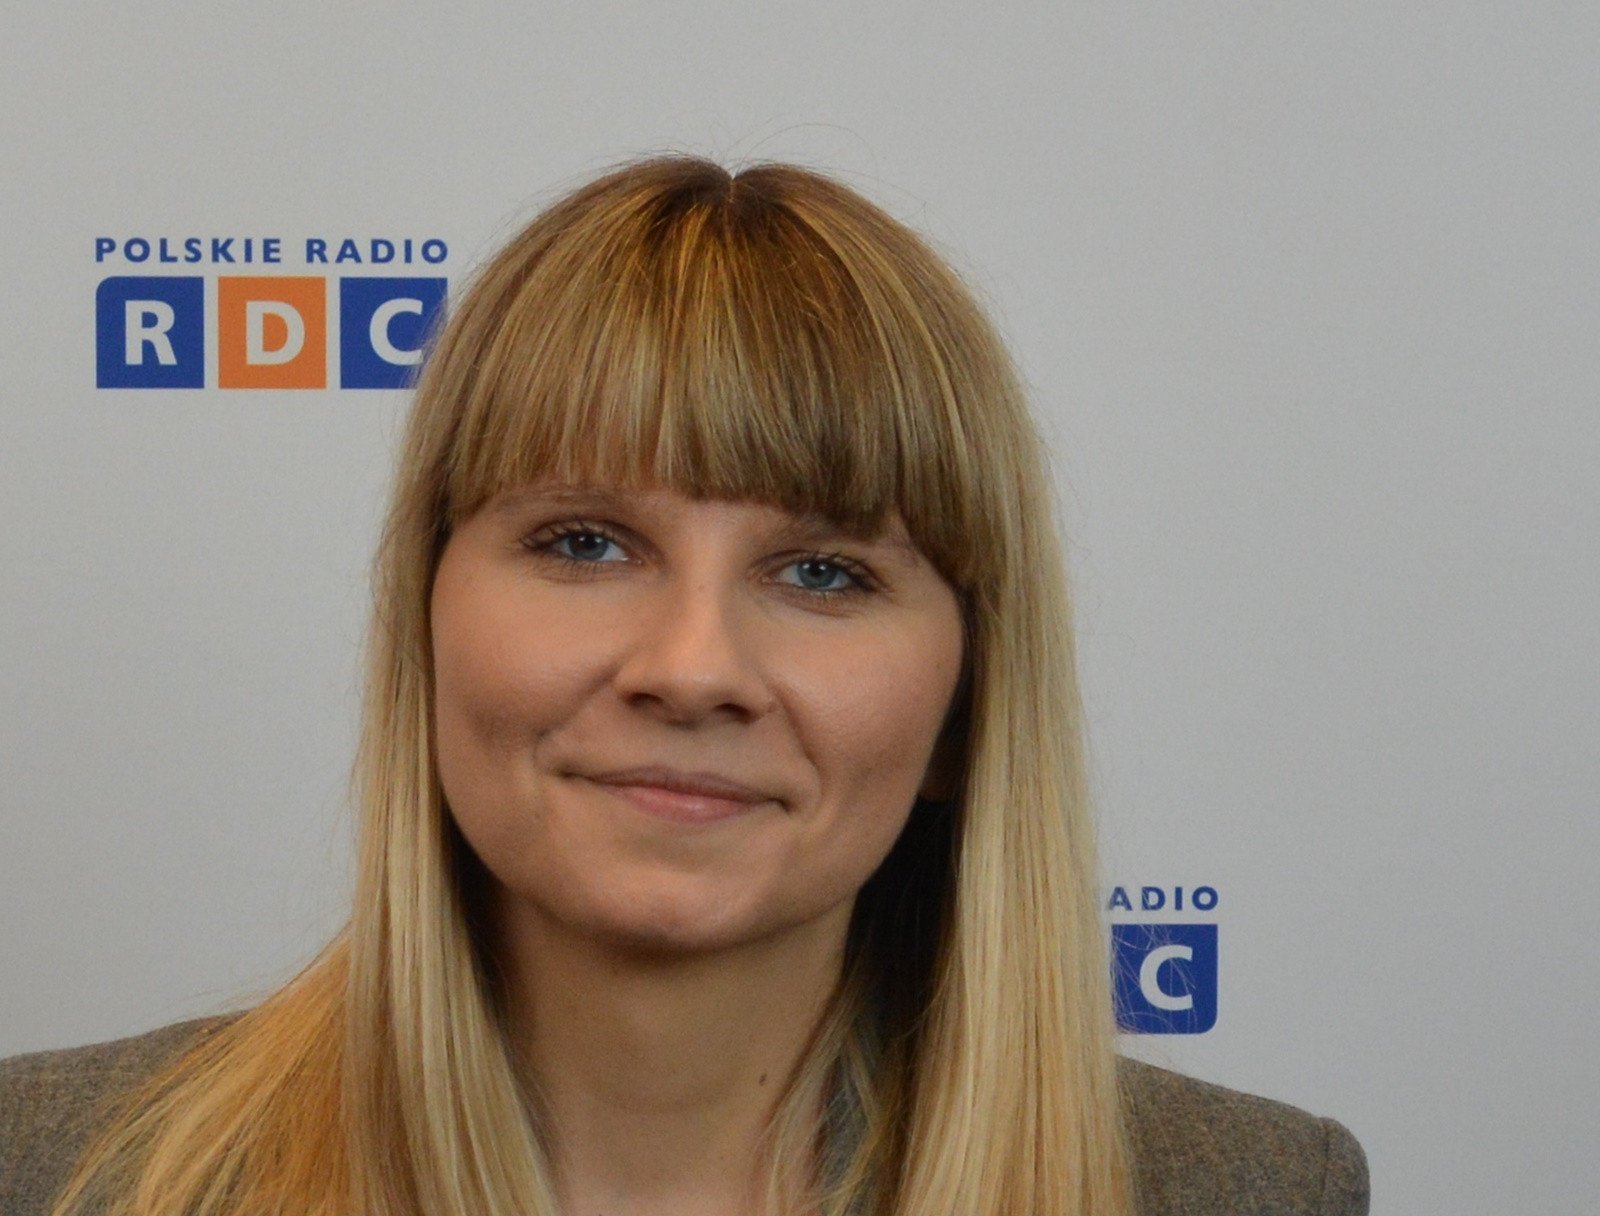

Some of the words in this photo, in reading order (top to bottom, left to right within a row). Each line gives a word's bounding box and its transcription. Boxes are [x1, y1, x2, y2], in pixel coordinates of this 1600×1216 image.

[95, 237, 281, 265] POLSKIE
[304, 238, 449, 265] RADIO
[125, 298, 424, 366] RDC
[1108, 885, 1220, 912] ADIO
